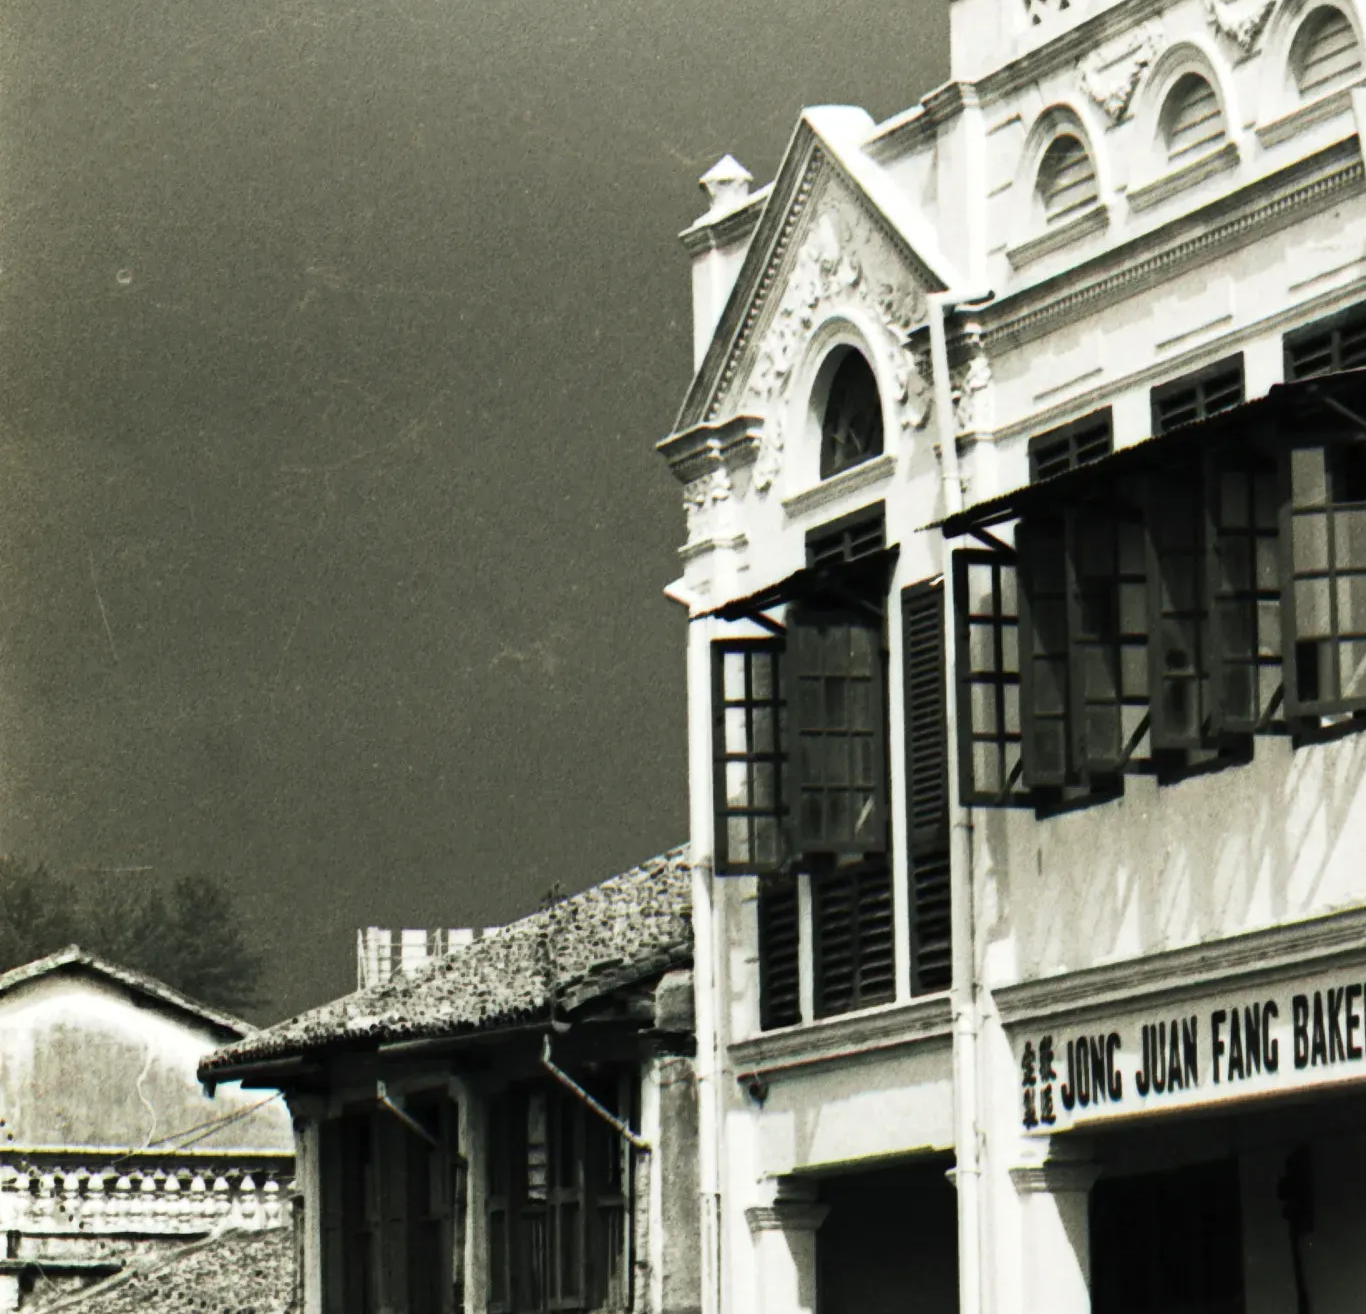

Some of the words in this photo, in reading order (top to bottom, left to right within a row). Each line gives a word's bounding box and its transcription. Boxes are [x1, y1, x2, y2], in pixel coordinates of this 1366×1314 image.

[1061, 1032, 1122, 1110] JONG
[1136, 1015, 1198, 1096] JUAN
[1211, 999, 1279, 1084] FANG
